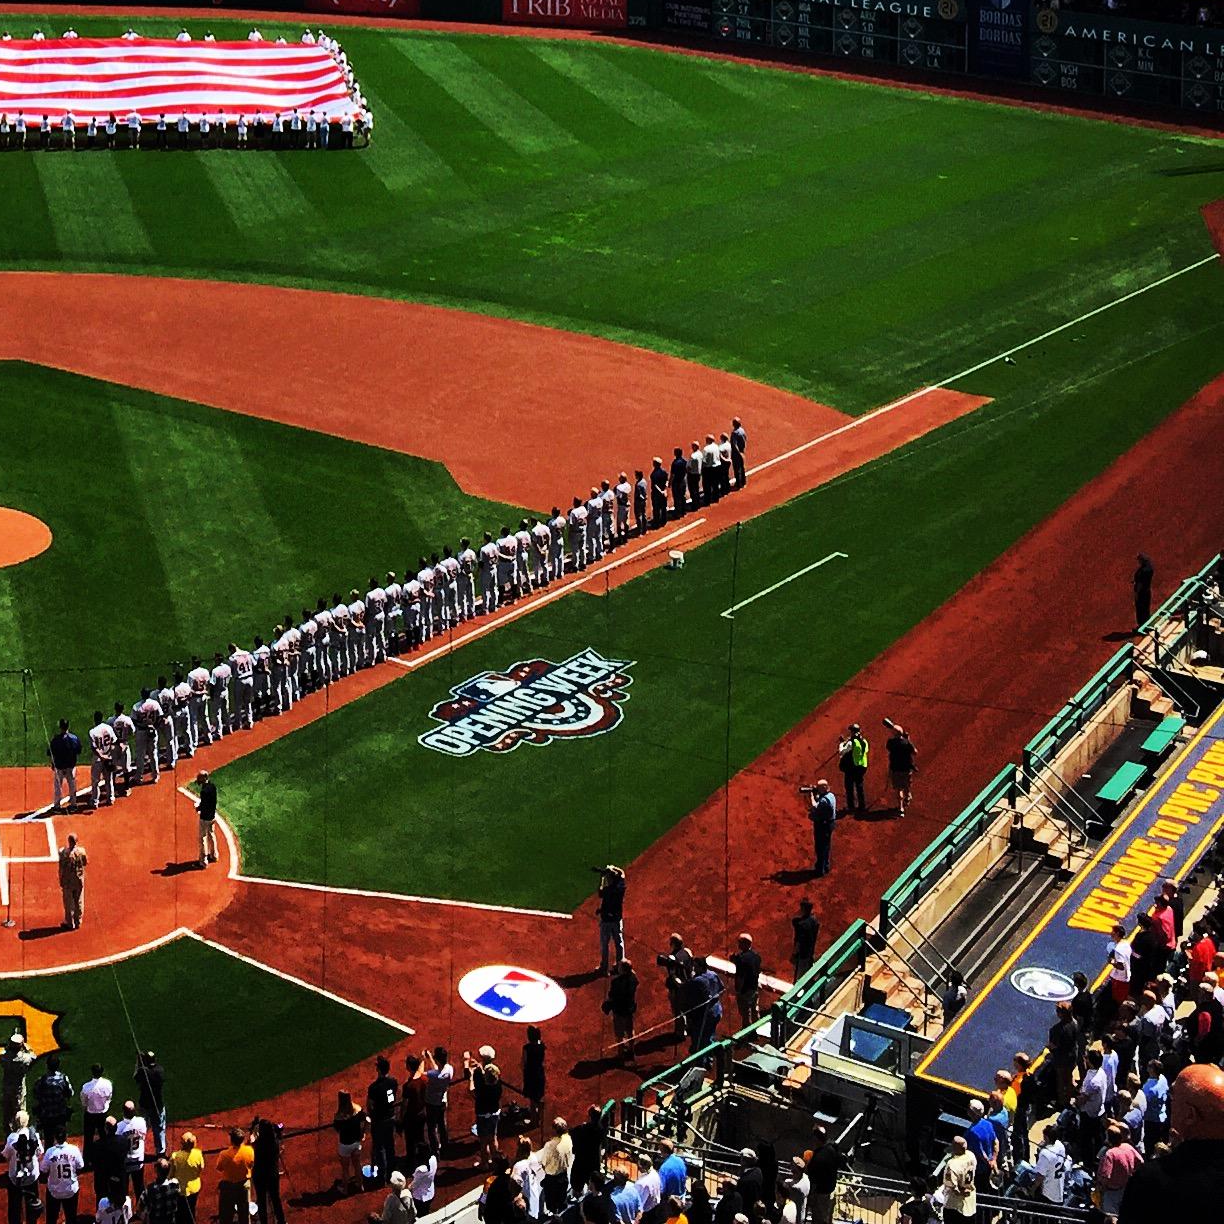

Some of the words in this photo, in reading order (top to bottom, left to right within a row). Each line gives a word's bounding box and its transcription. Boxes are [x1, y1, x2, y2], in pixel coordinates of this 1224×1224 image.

[579, 4, 624, 21] MEDIA
[1064, 25, 1194, 53] AMERICAN
[424, 687, 557, 755] OPENING
[528, 651, 625, 696] WEEK
[1158, 781, 1221, 825] PNC
[1147, 817, 1188, 842] TO
[1066, 836, 1178, 934] WELCOME
[56, 1163, 72, 1180] 15
